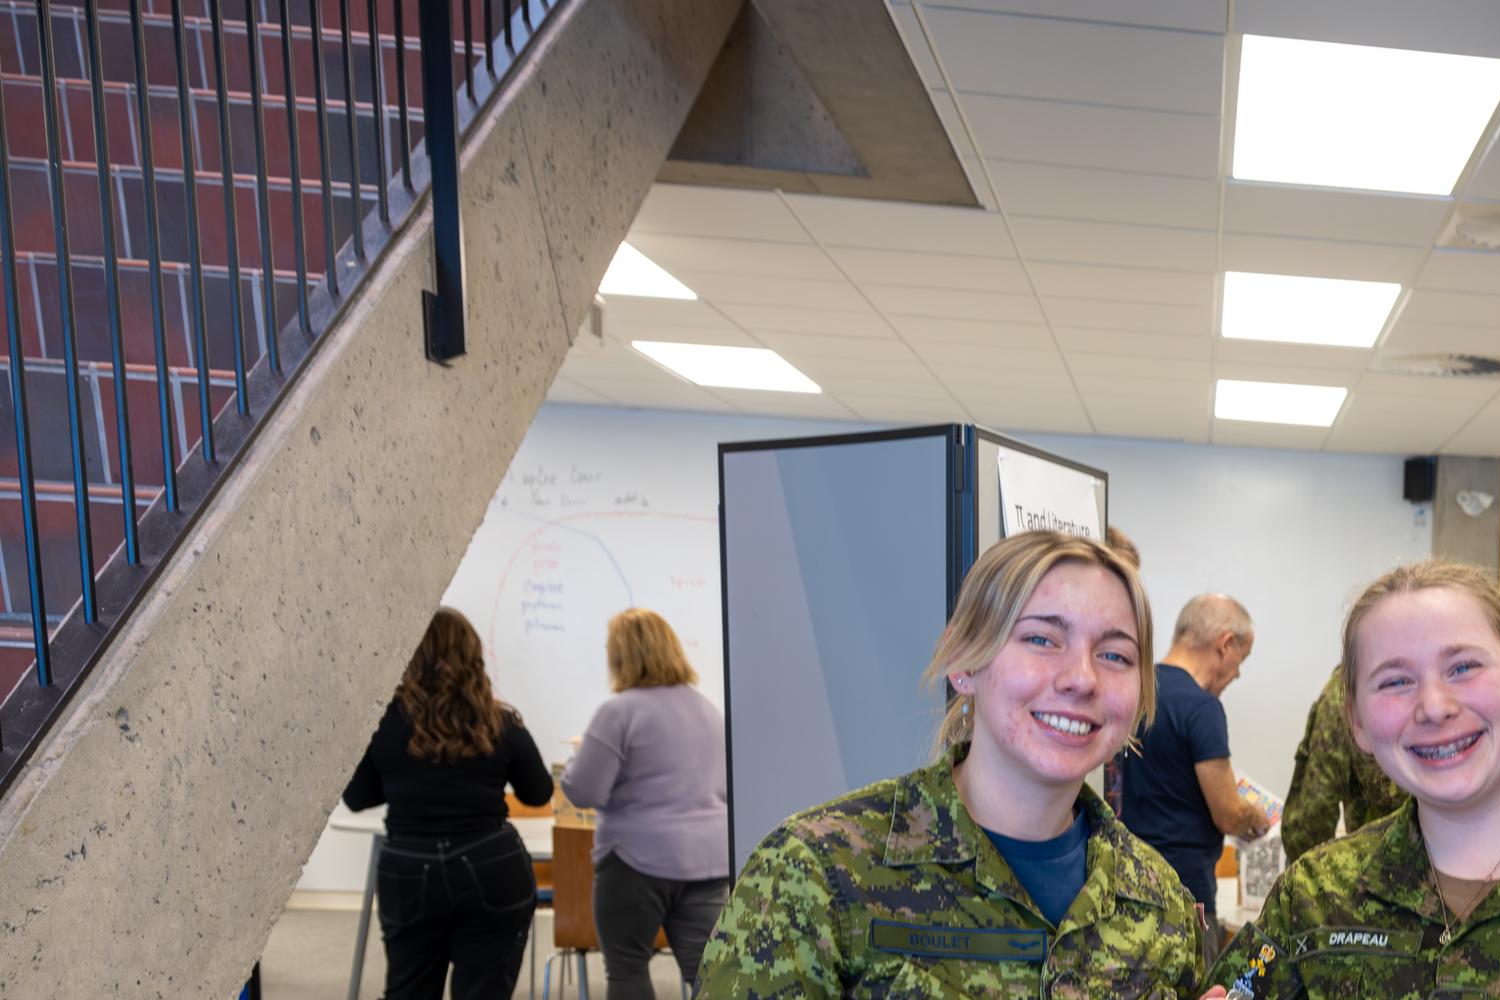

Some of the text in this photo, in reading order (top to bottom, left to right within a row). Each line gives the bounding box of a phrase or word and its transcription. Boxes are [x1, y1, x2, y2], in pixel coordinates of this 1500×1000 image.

[1027, 509, 1047, 532] and
[909, 934, 971, 950] BOULET
[1328, 932, 1389, 947] DRAPEAU
